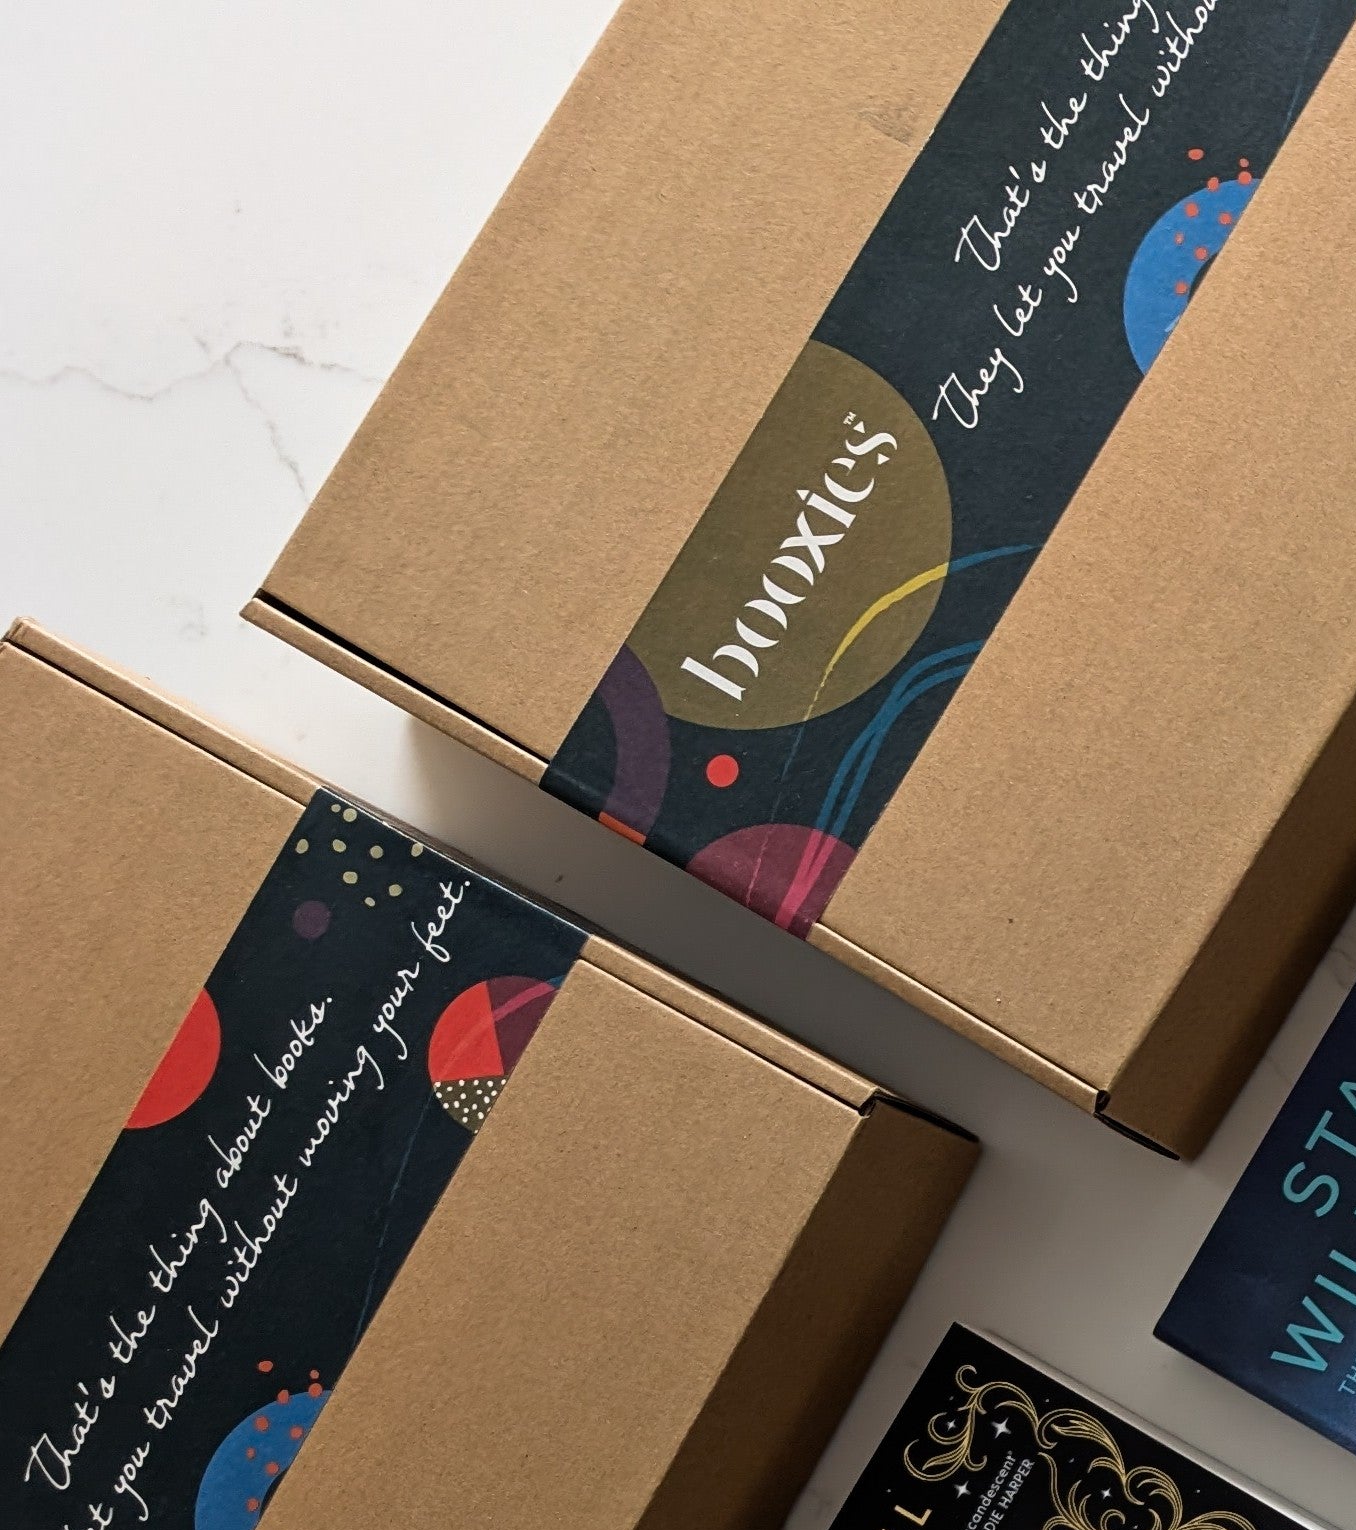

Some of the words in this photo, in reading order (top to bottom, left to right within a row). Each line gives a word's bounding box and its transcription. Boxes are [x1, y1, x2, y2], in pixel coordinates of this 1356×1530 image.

[680, 421, 898, 701] booxies
[24, 1375, 116, 1490] That's
[108, 1305, 156, 1364] the
[148, 1198, 227, 1293] thing
[207, 1094, 271, 1189] about
[253, 997, 333, 1090] books.
[113, 1441, 150, 1522] you
[143, 1305, 219, 1430] travel
[220, 1173, 298, 1309] without
[299, 1045, 385, 1167] moving
[372, 961, 420, 1061] your
[410, 880, 471, 963] feet.
[996, 1456, 1036, 1509] HARPER
